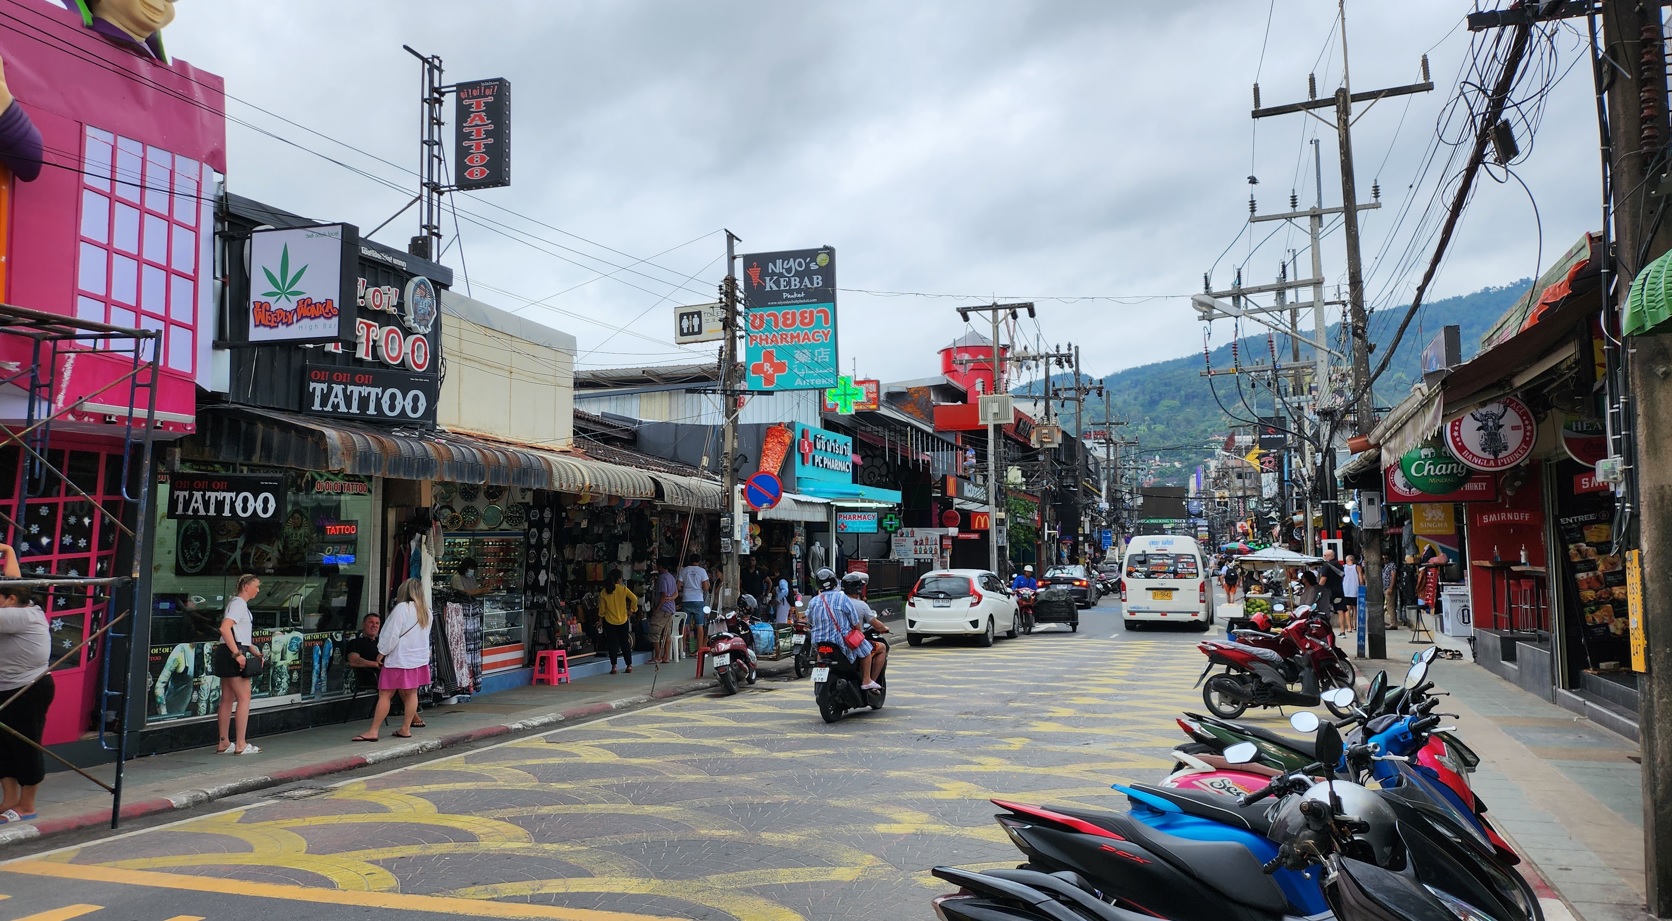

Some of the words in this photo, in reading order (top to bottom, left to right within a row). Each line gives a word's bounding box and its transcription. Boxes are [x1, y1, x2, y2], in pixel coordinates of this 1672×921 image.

[463, 97, 494, 180] TATTOO
[768, 257, 819, 277] NIYO's
[764, 275, 823, 291] KEBAB
[253, 301, 296, 329] WEEDLY
[295, 297, 340, 323] WONKA
[749, 307, 831, 331] ขายยา
[298, 323, 319, 331] High
[322, 322, 337, 330] Bar
[748, 329, 832, 347] PHARMACY
[309, 381, 427, 418] TATTOO
[1461, 449, 1496, 467] BANGLA
[1497, 442, 1529, 466] PHUKET
[814, 455, 823, 468] PC
[823, 456, 853, 473] PHARMACY
[1410, 460, 1467, 477] Chang
[342, 482, 368, 493] TATTOO
[174, 490, 276, 518] TATTOO
[1482, 512, 1530, 523] SMIRNOFF
[325, 525, 356, 535] TATTOO
[325, 545, 355, 555] OPEN
